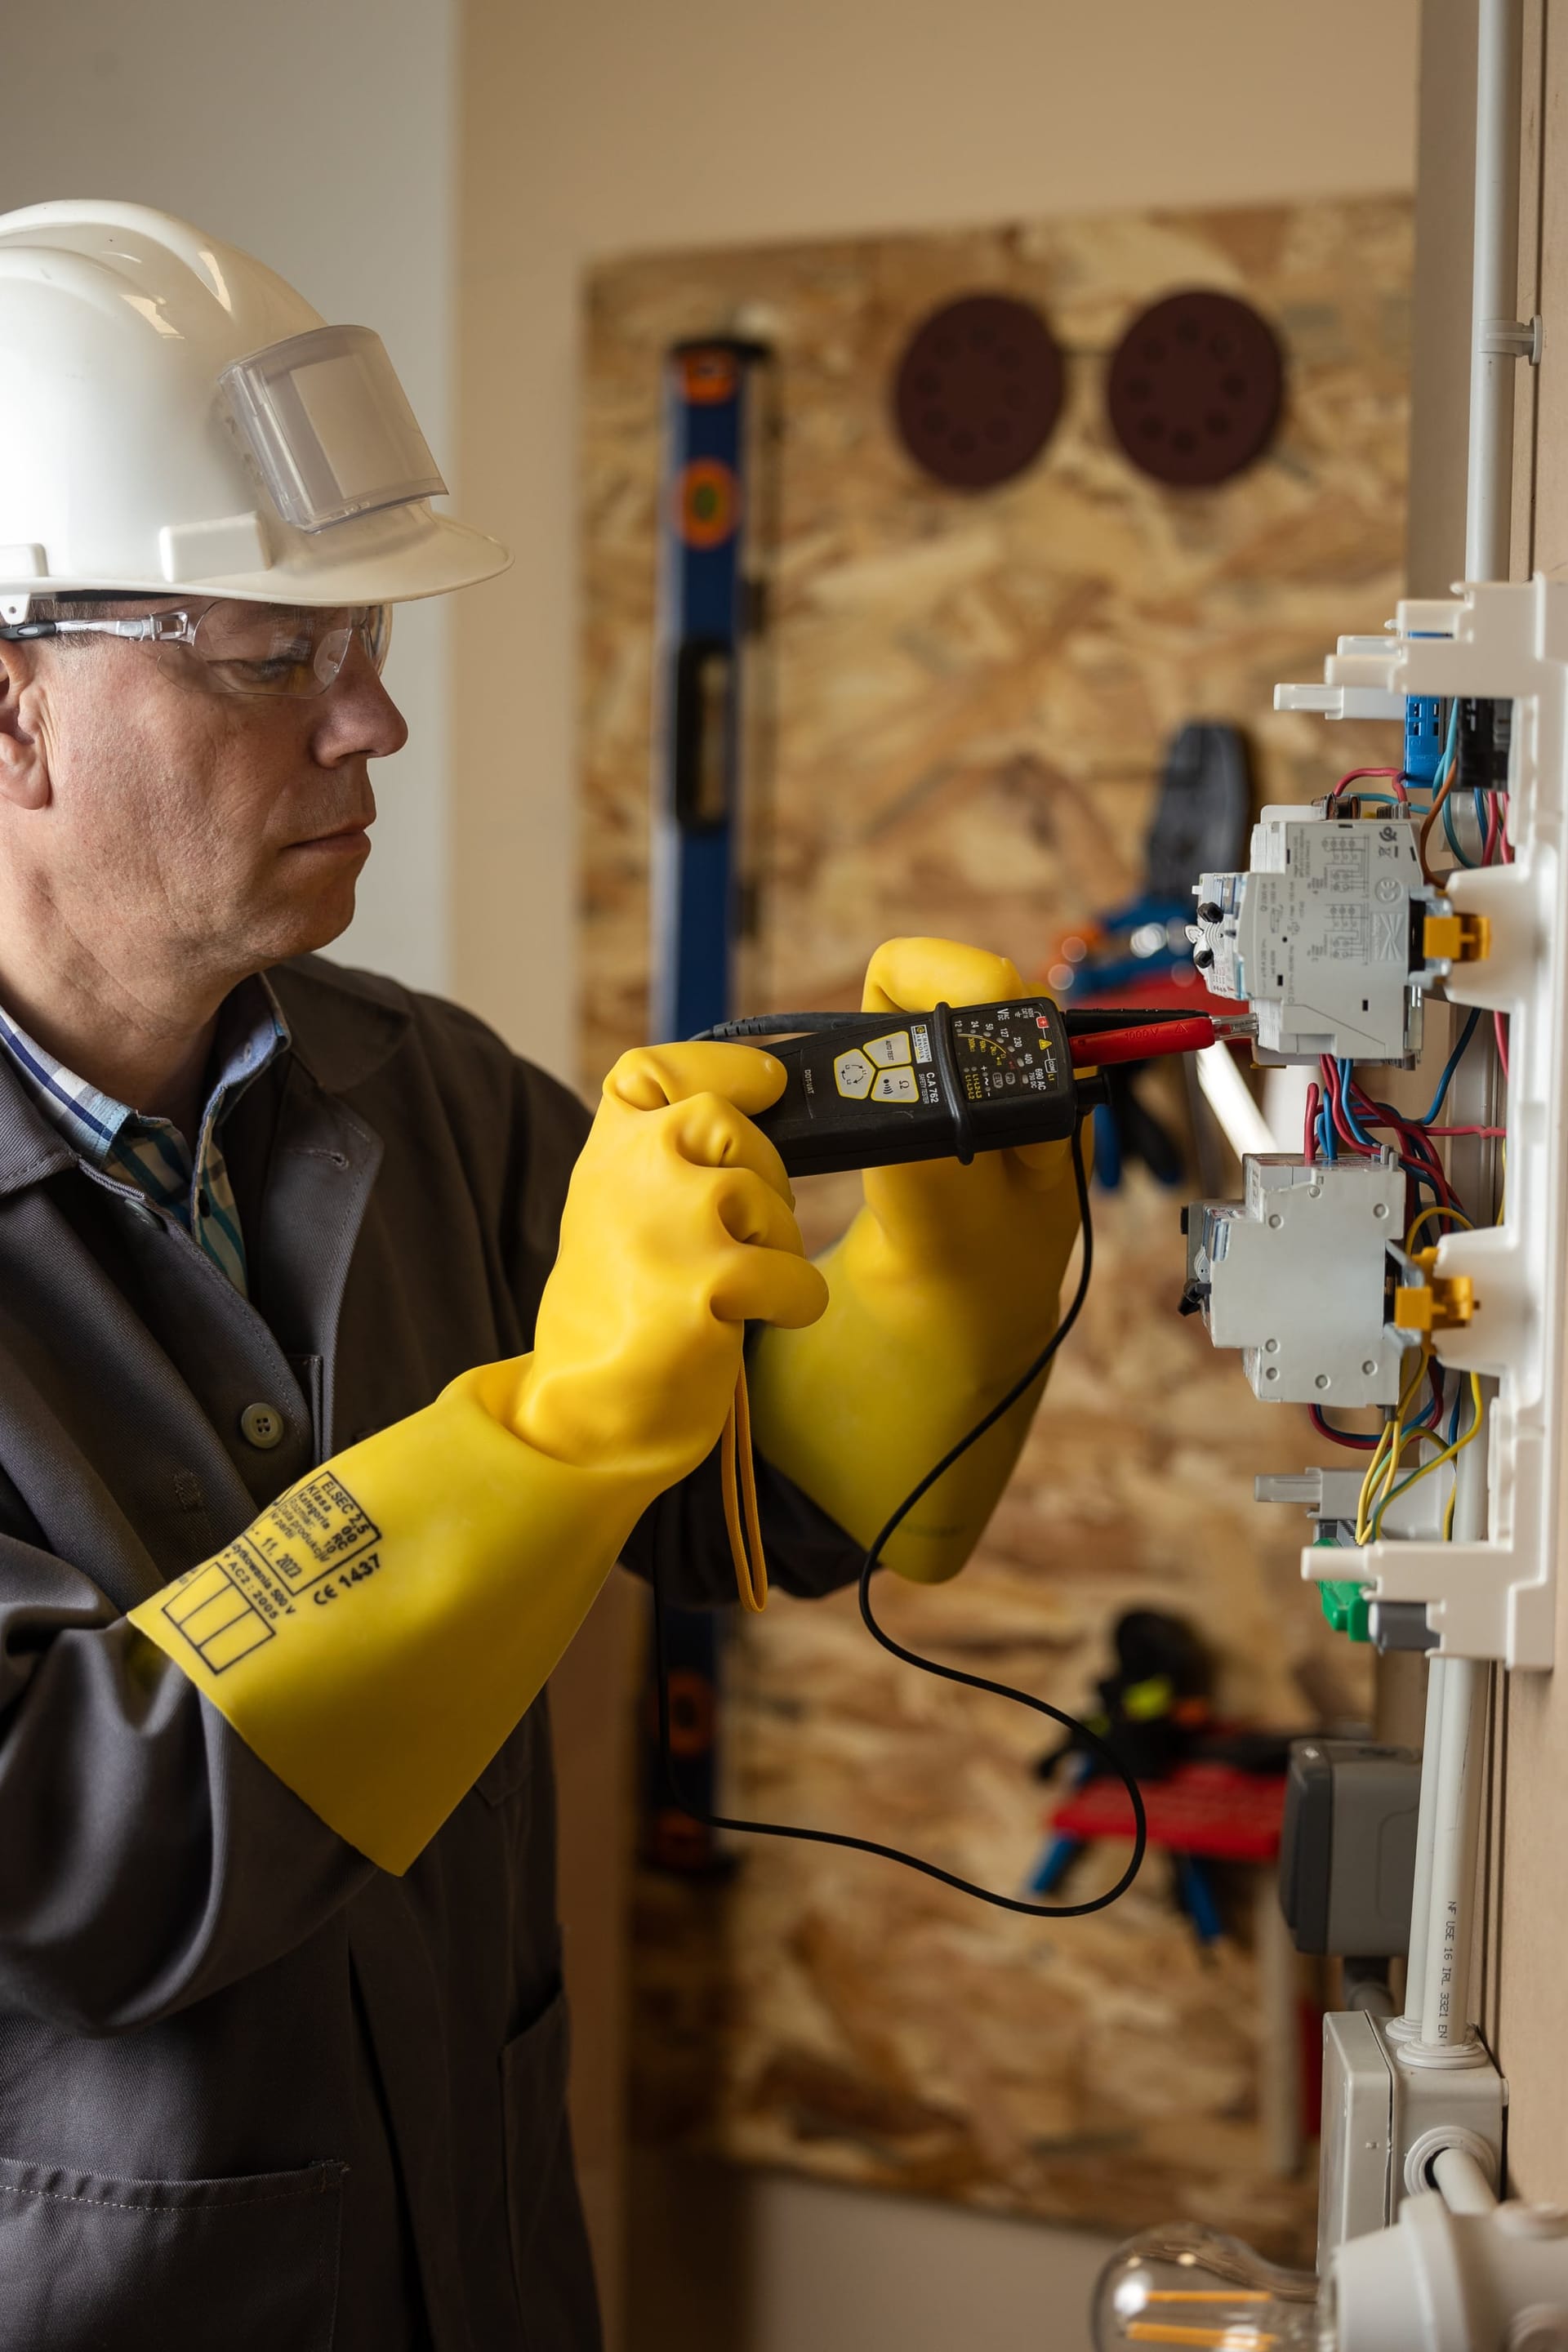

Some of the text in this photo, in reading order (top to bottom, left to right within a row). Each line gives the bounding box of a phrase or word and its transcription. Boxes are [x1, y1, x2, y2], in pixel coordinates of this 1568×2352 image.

[1000, 1028, 1009, 1037] 127
[1013, 1037, 1022, 1047] 230
[926, 1072, 938, 1102] C.A 762
[1035, 1068, 1045, 1090] 690 AC
[307, 1485, 358, 1543] Klasa 00
[322, 1481, 354, 1514] ELSEC
[299, 1493, 348, 1550] Kategoria RC
[339, 1553, 380, 1588] 1437
[1438, 1901, 1458, 2038] NF USE 16 IRL 3321 EN
